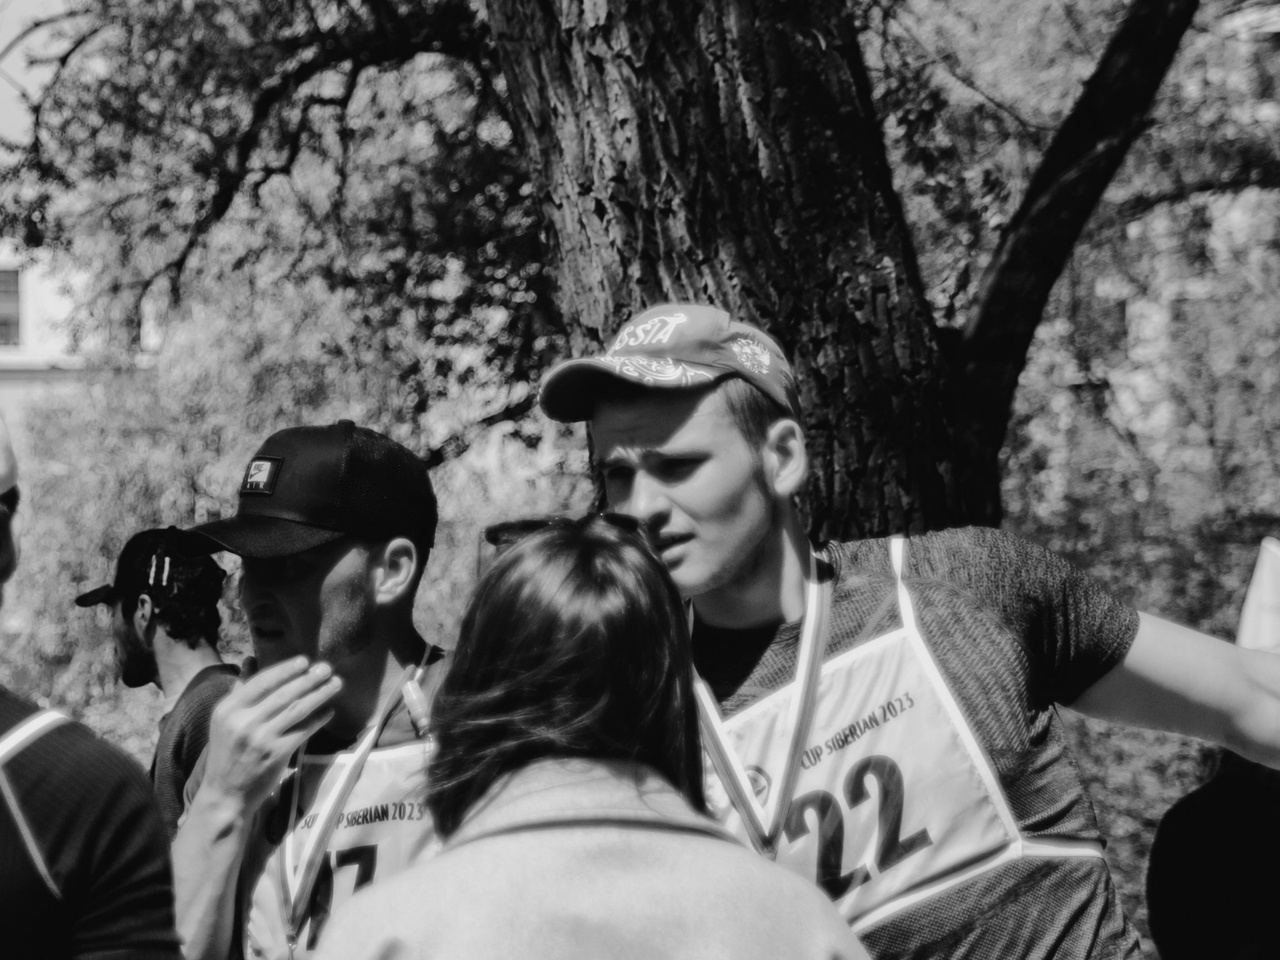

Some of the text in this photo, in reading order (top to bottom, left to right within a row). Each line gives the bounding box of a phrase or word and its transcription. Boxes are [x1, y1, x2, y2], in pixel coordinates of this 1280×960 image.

[801, 691, 915, 770] CUP SIBERIAN 2023
[344, 804, 389, 829] SIBERIAN
[392, 802, 424, 821] 2023
[784, 755, 933, 902] 22
